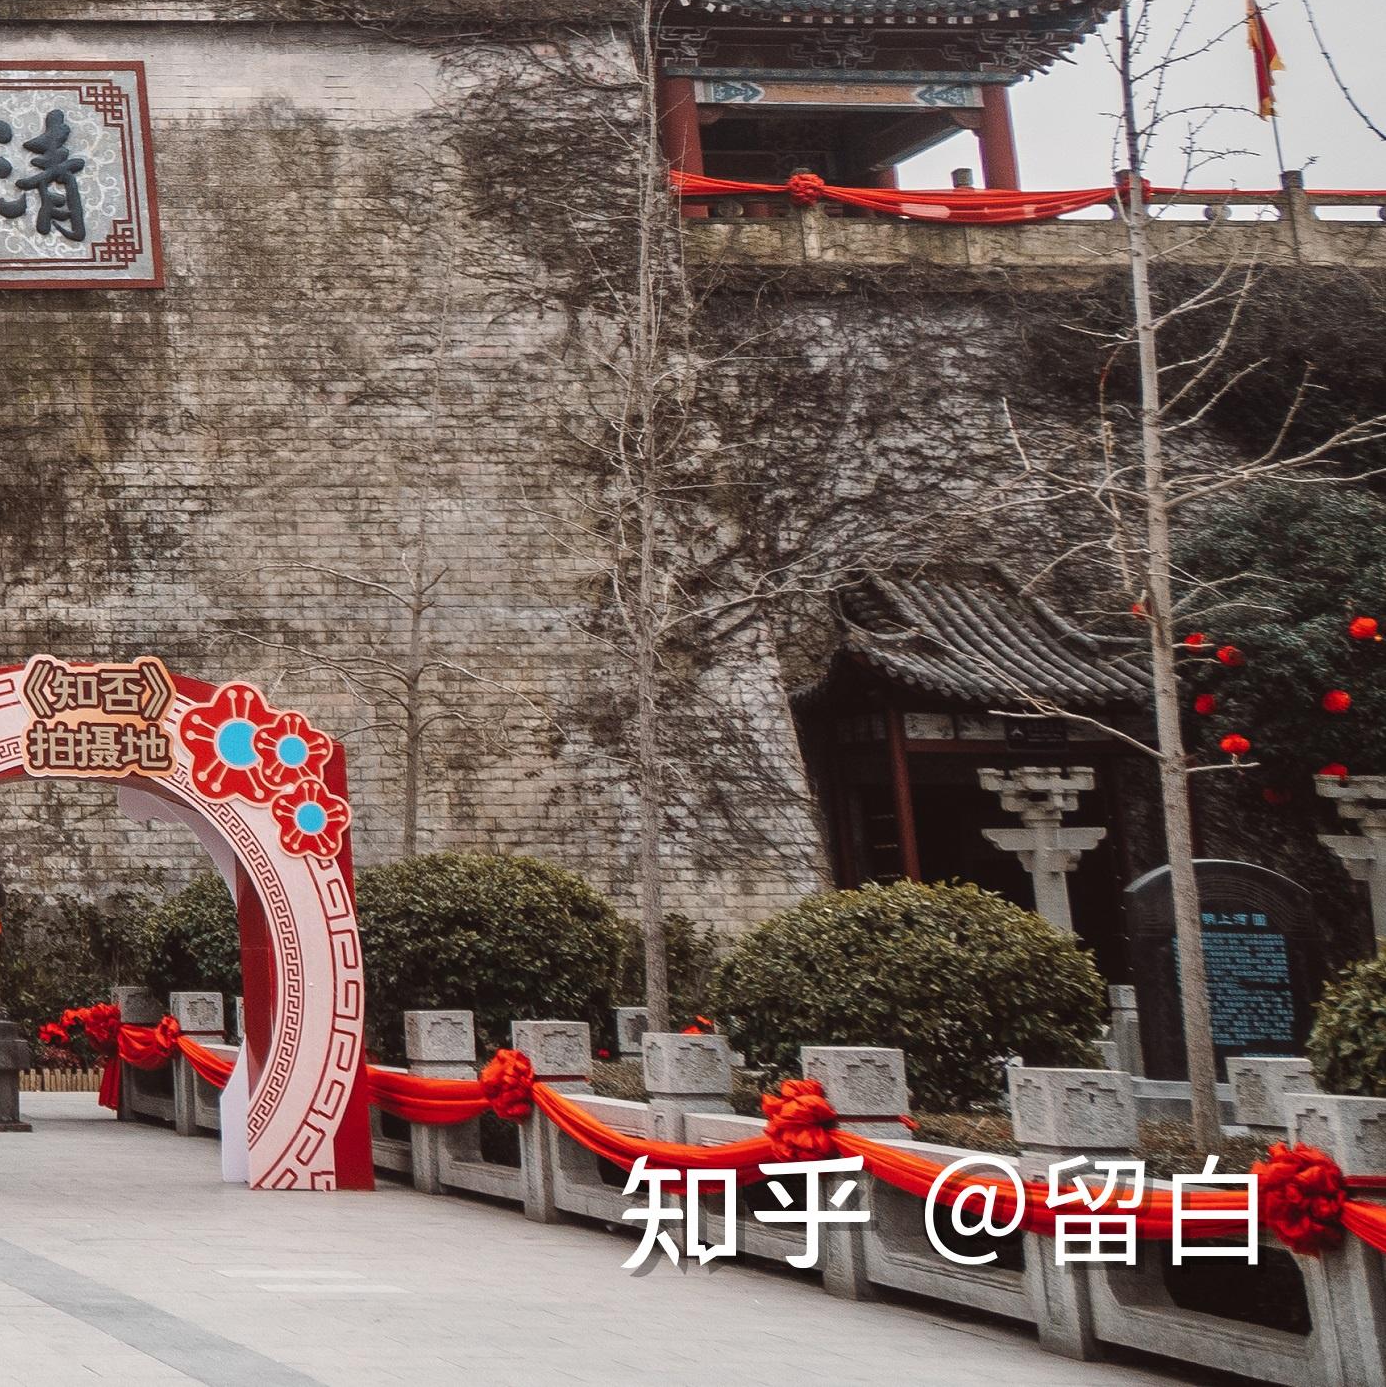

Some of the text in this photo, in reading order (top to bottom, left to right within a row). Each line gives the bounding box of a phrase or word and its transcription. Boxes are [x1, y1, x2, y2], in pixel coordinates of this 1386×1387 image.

[23, 659, 171, 720] 《知否》
[28, 721, 172, 771] 拍摄地
